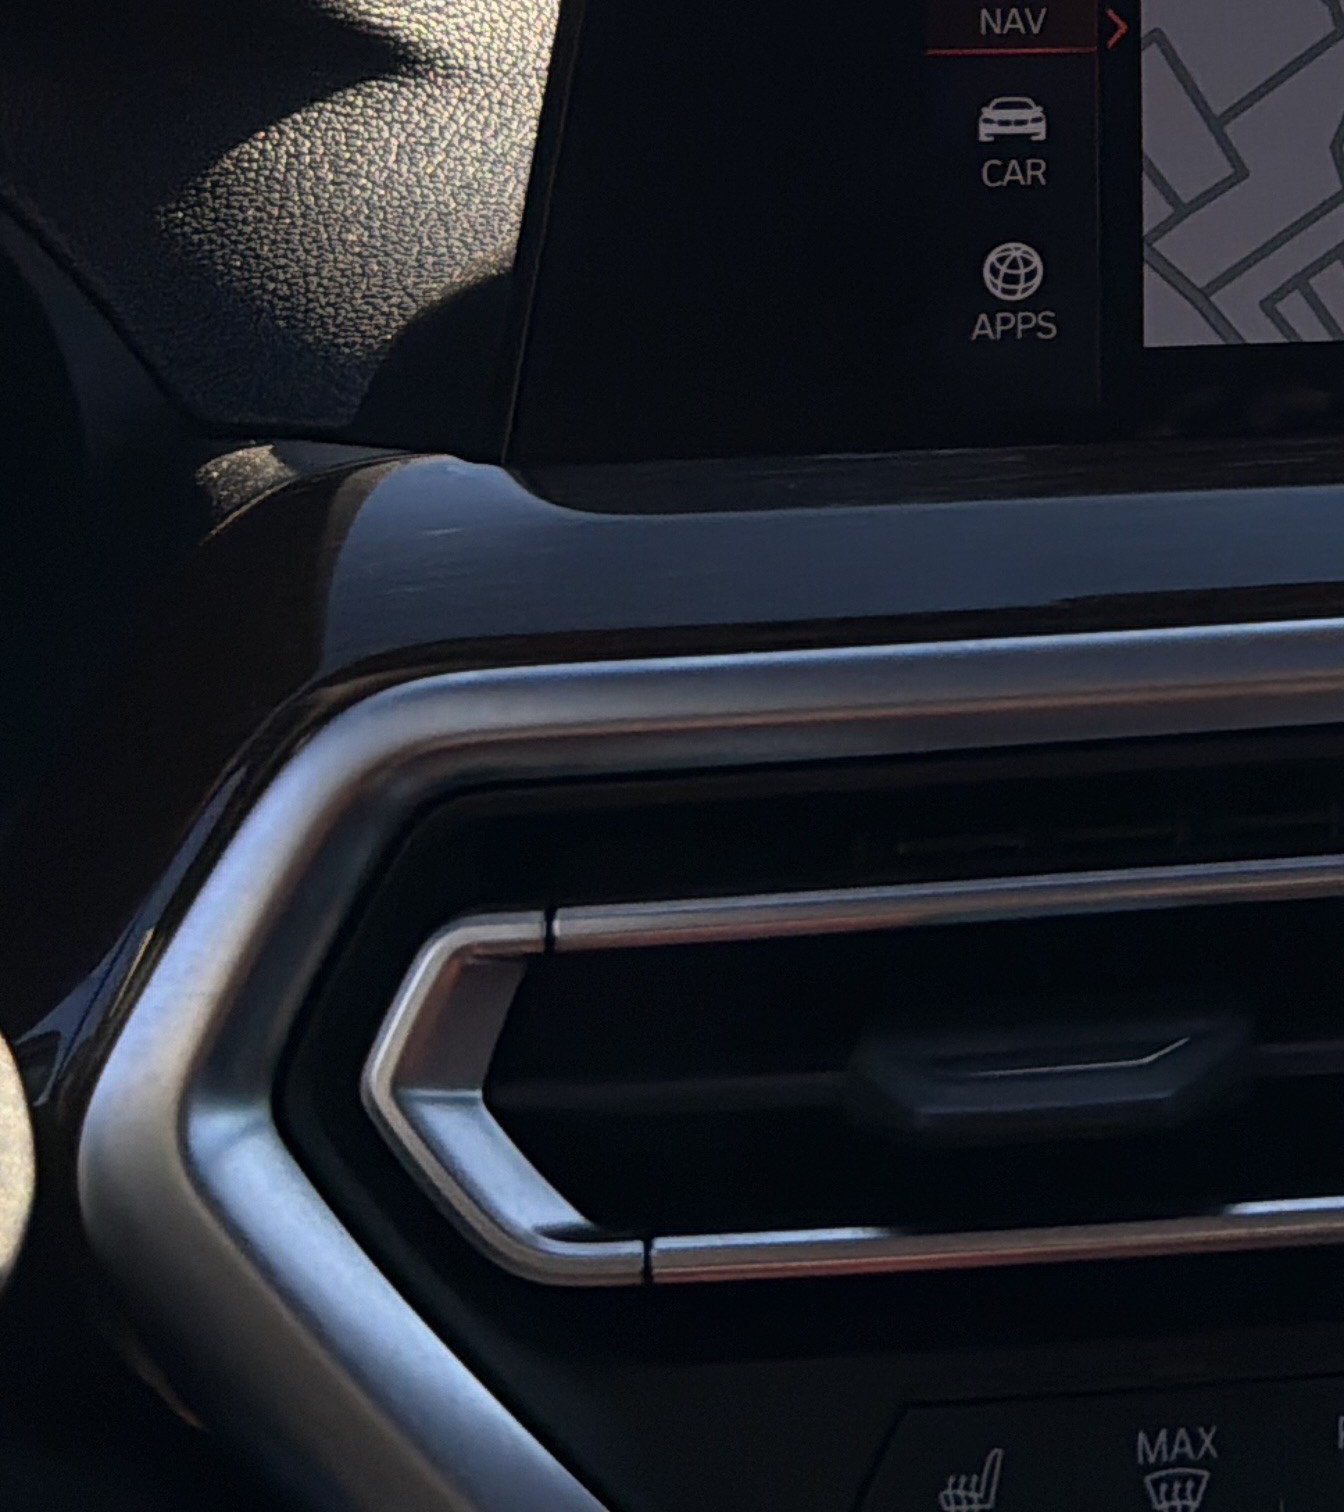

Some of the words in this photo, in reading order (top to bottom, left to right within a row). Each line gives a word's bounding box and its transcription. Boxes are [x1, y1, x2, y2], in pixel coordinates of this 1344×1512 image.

[981, 8, 1046, 34] NAV
[982, 159, 1046, 187] CAR
[972, 311, 1057, 340] APPS
[1137, 1426, 1217, 1464] MAX
